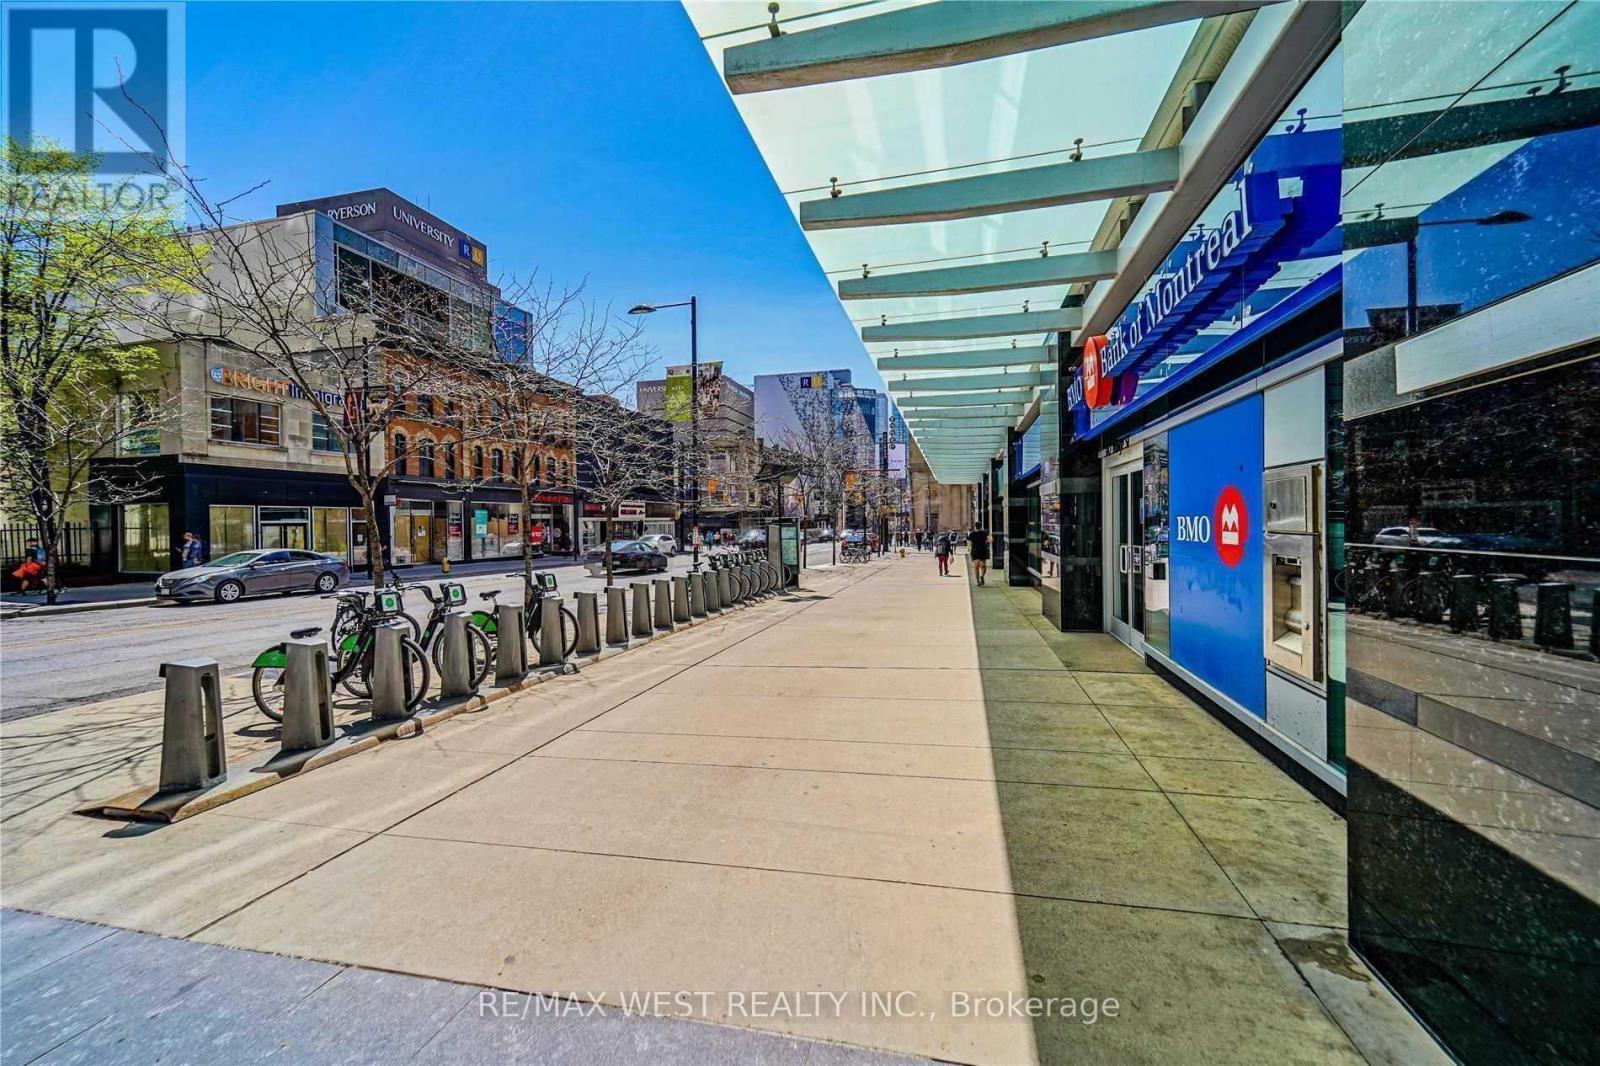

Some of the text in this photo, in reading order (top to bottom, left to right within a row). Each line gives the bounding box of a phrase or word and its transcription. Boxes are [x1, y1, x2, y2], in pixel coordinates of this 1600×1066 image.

[327, 202, 455, 248] RYERSON UNIVERSITY
[1100, 178, 1252, 378] Bank of Montreal
[1066, 375, 1083, 412] BMO
[1177, 515, 1211, 543] BMO
